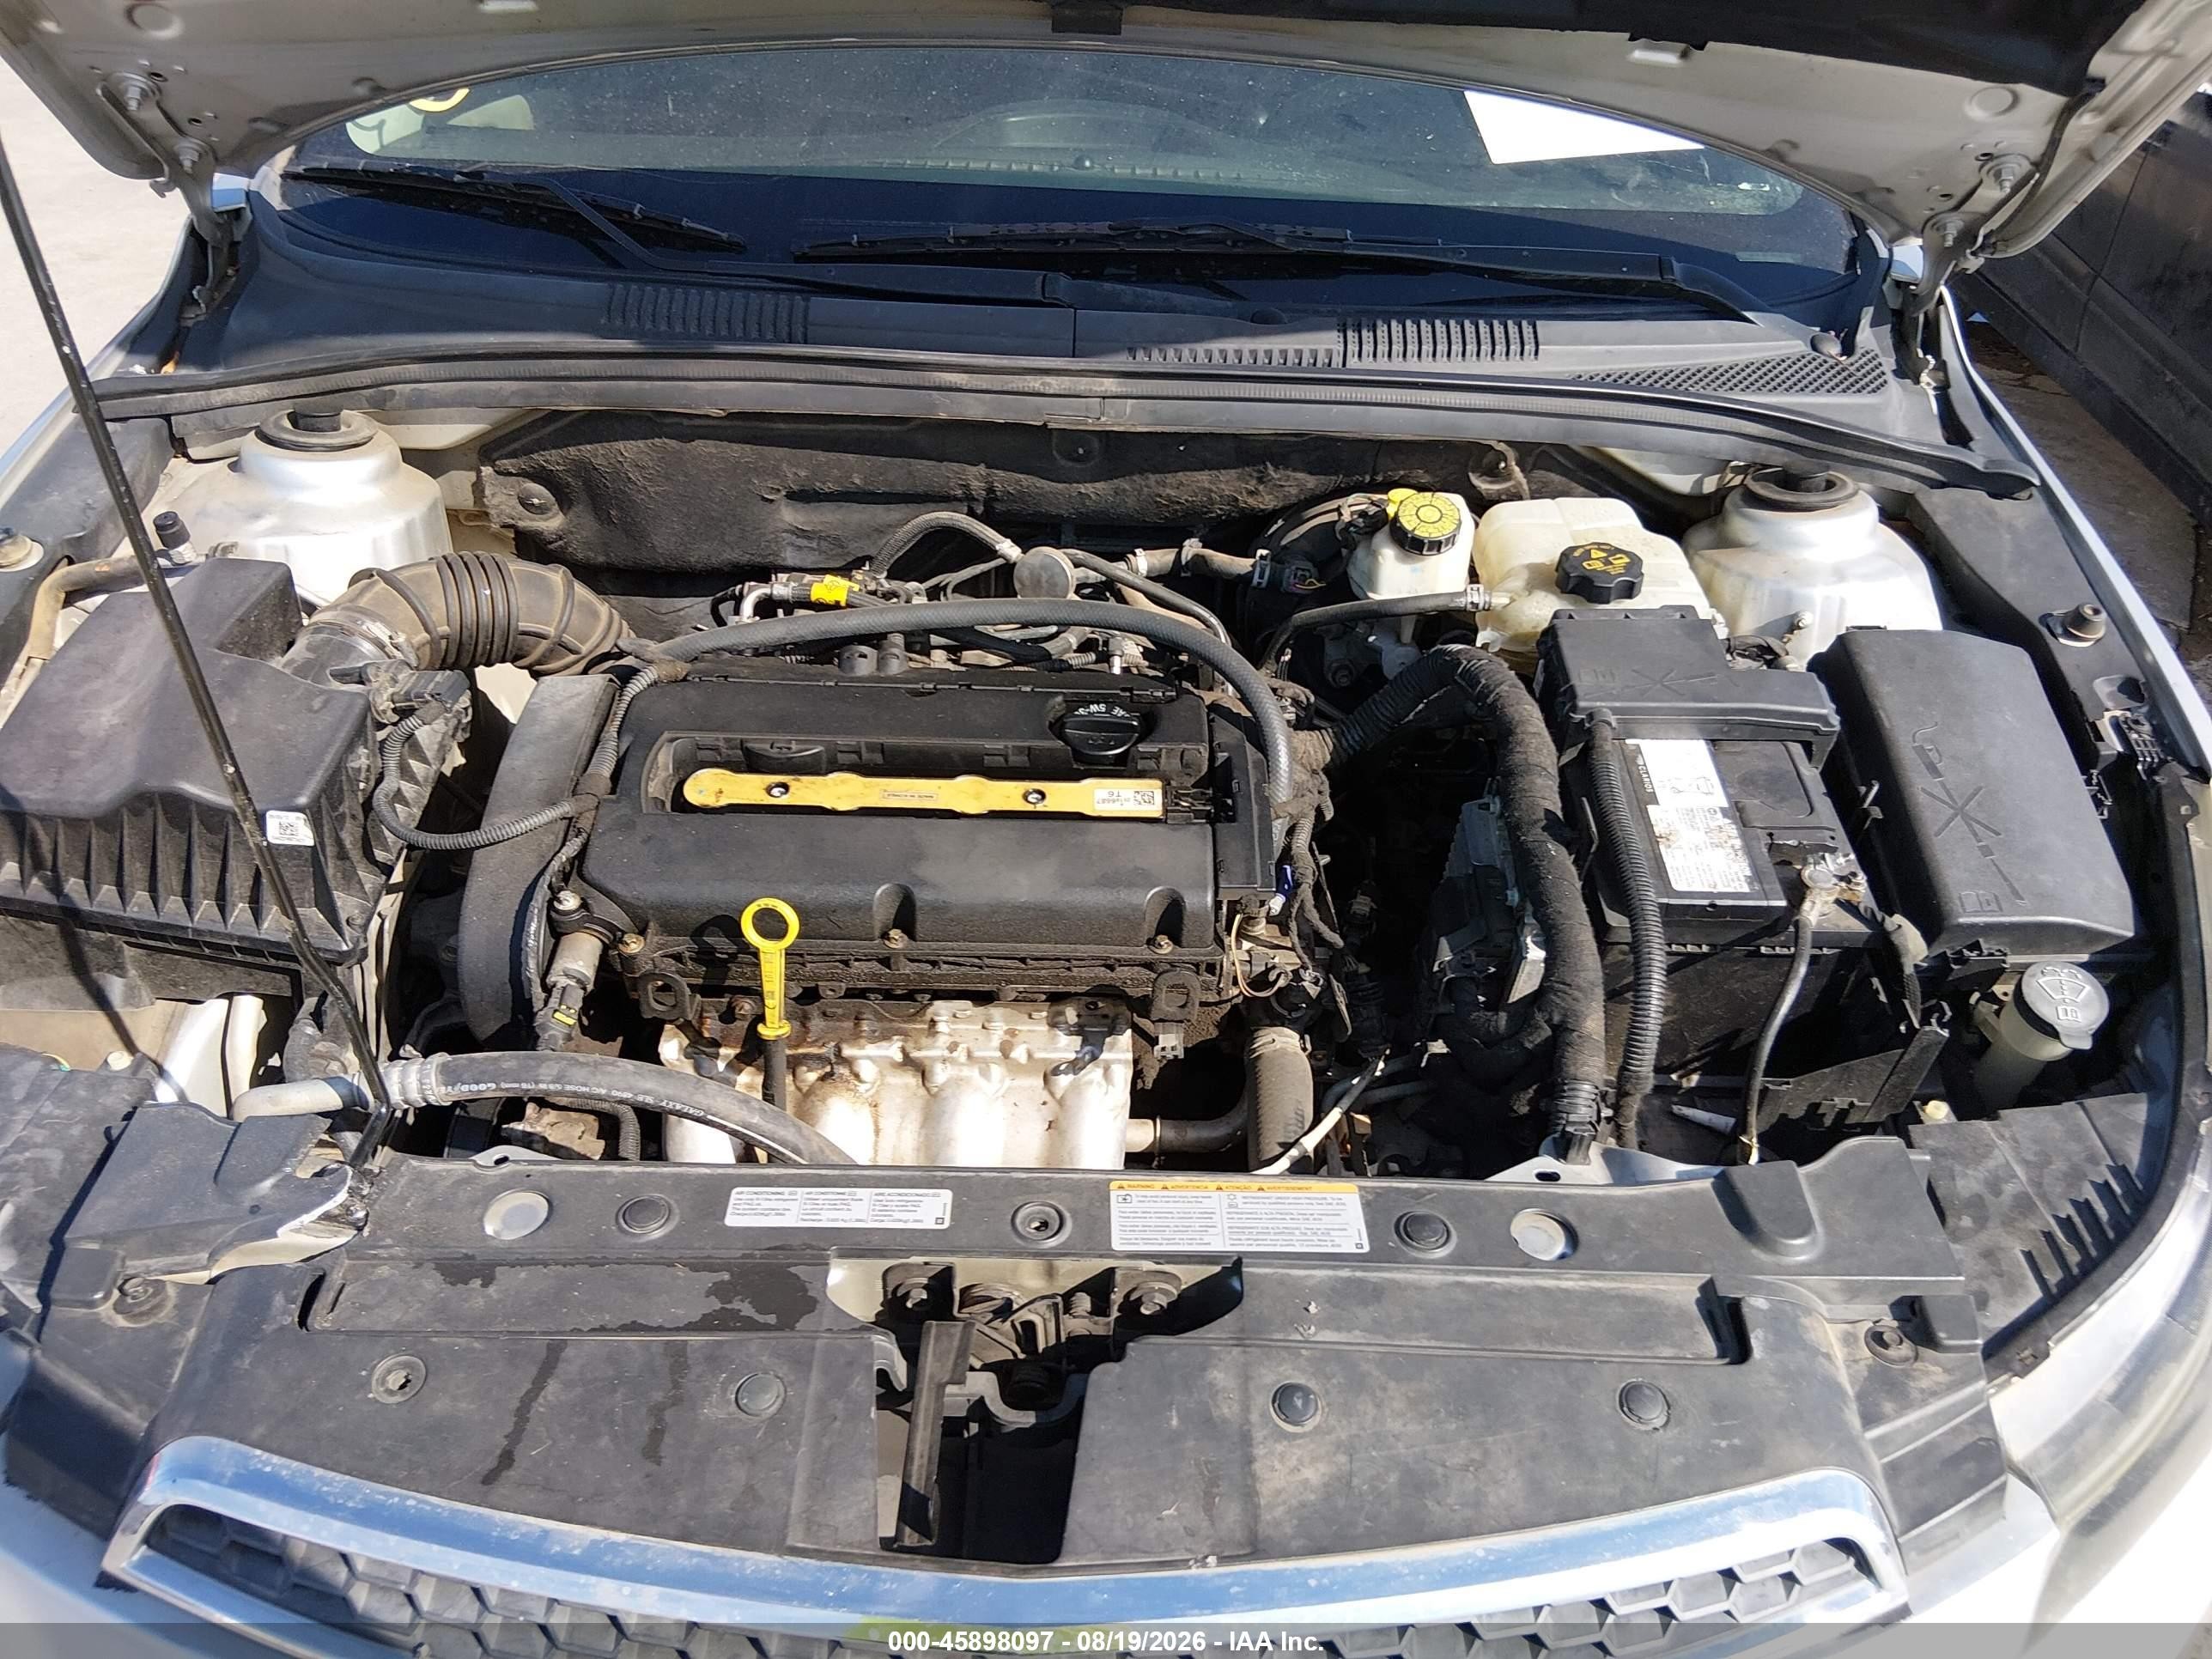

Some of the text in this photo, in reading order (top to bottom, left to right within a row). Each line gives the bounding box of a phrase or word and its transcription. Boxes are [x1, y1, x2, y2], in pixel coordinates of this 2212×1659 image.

[1638, 765, 1654, 793] CLARIOS
[563, 1084, 589, 1092] HOSE
[659, 1099, 704, 1117] GALAXY
